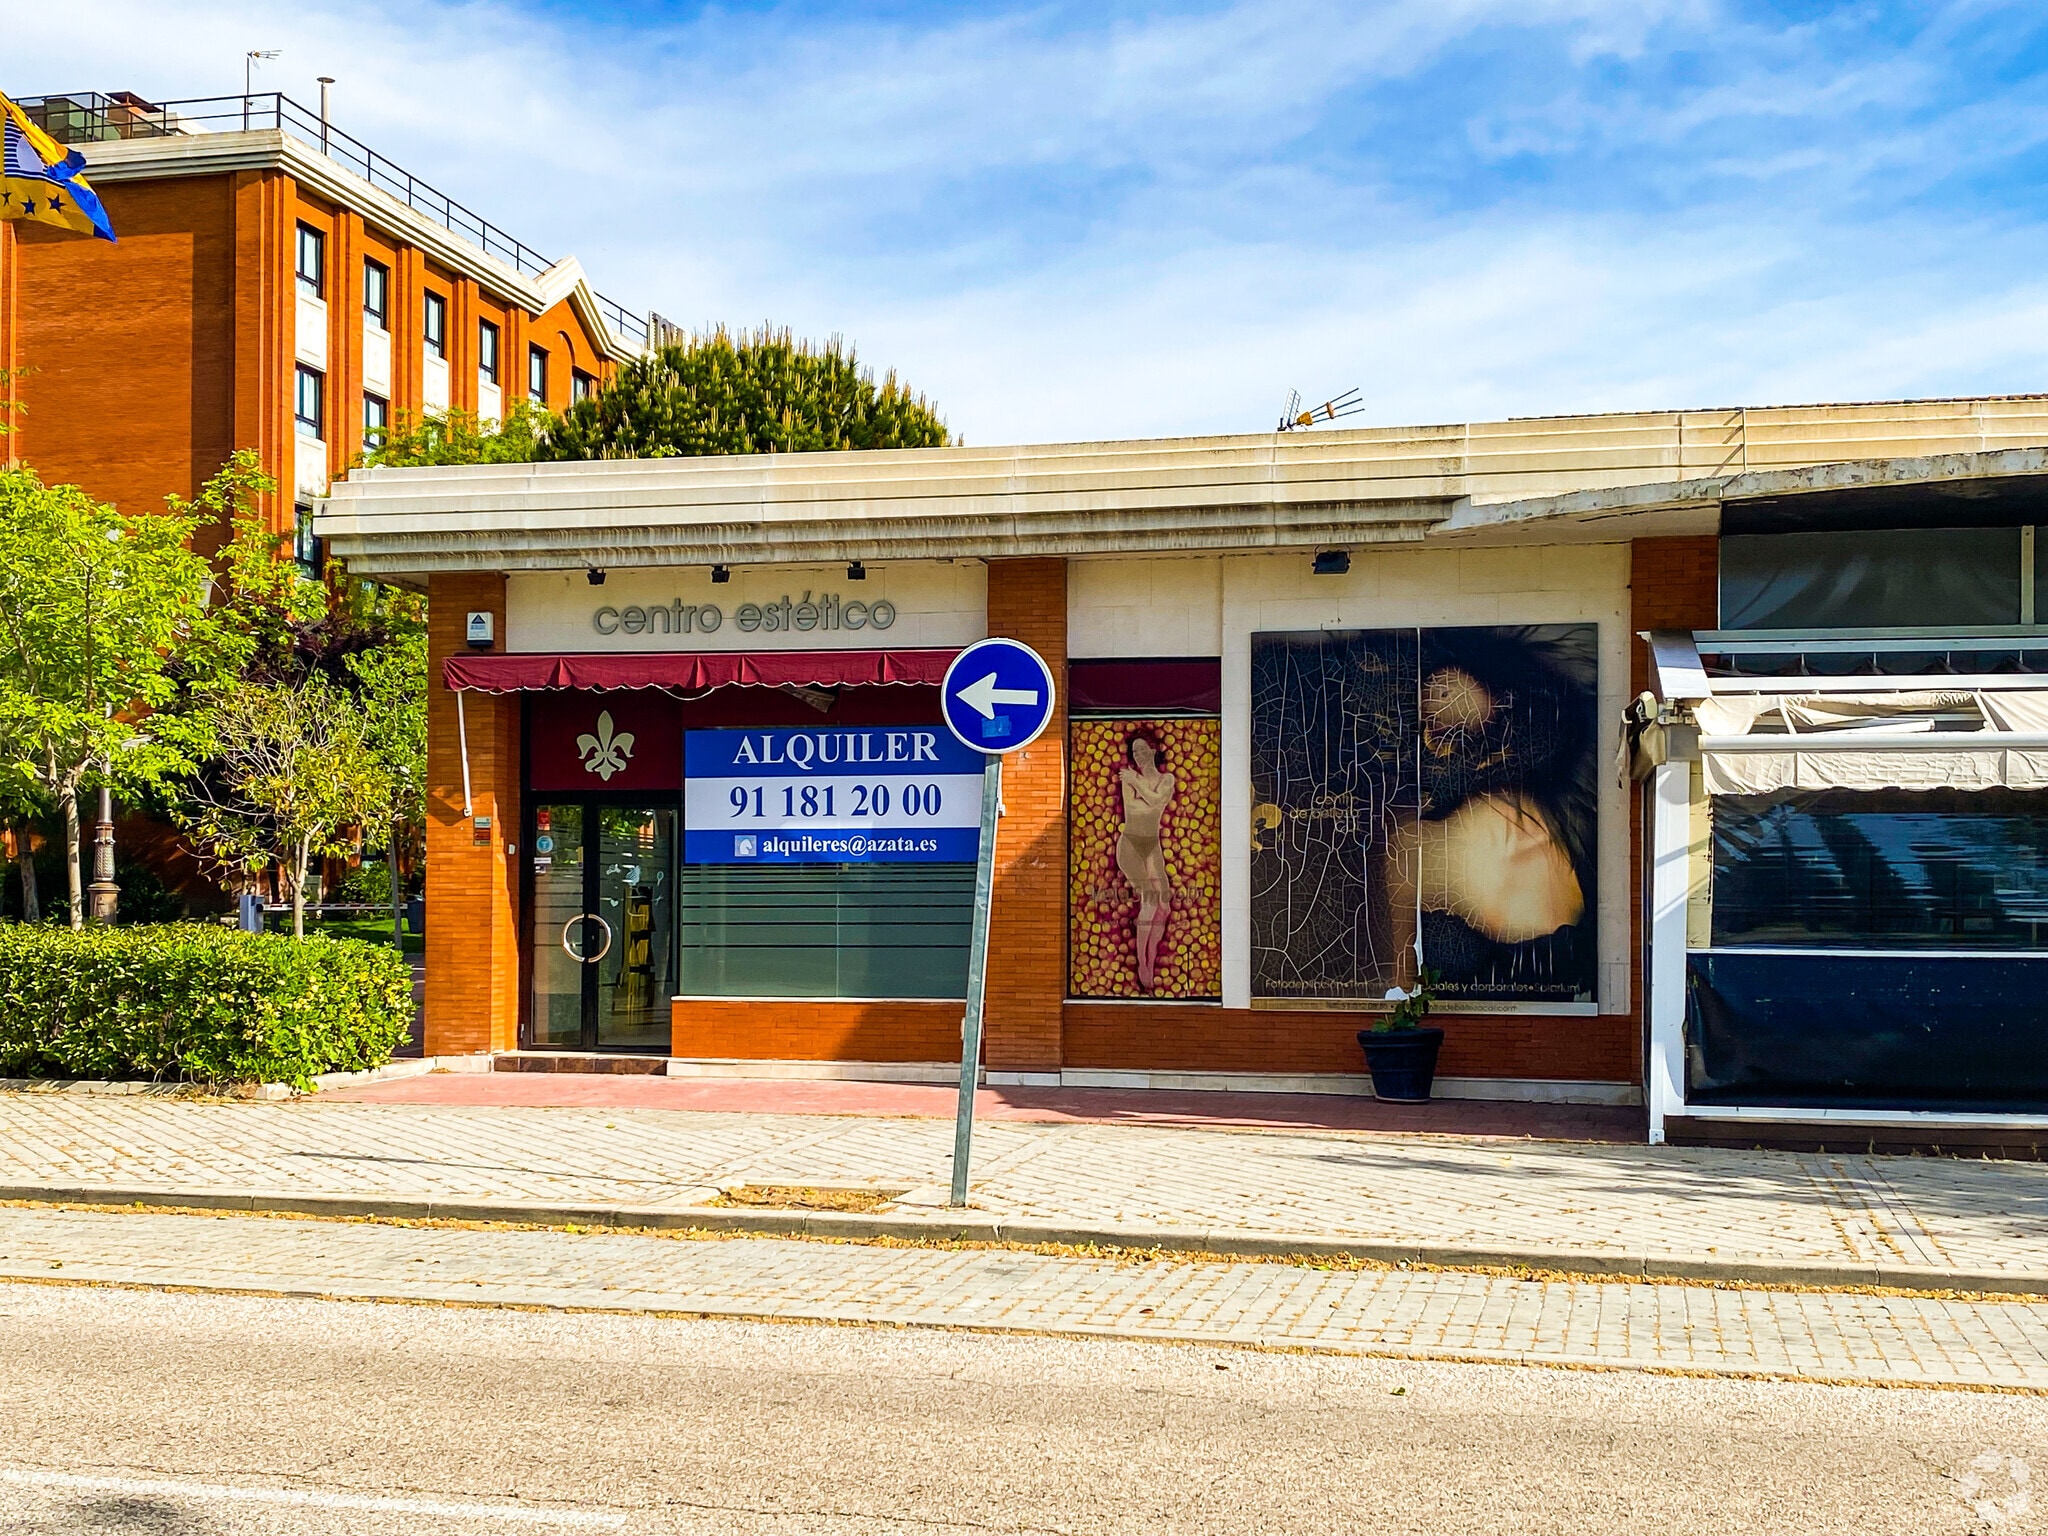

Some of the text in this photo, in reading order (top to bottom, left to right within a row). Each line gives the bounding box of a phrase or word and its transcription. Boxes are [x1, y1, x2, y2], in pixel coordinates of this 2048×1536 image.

[593, 590, 896, 635] centro estético
[732, 732, 940, 770] ALQUILER
[730, 783, 942, 818] 91 181 20 00
[762, 835, 938, 857] alquileres@azata.es
[1461, 983, 1468, 993] y
